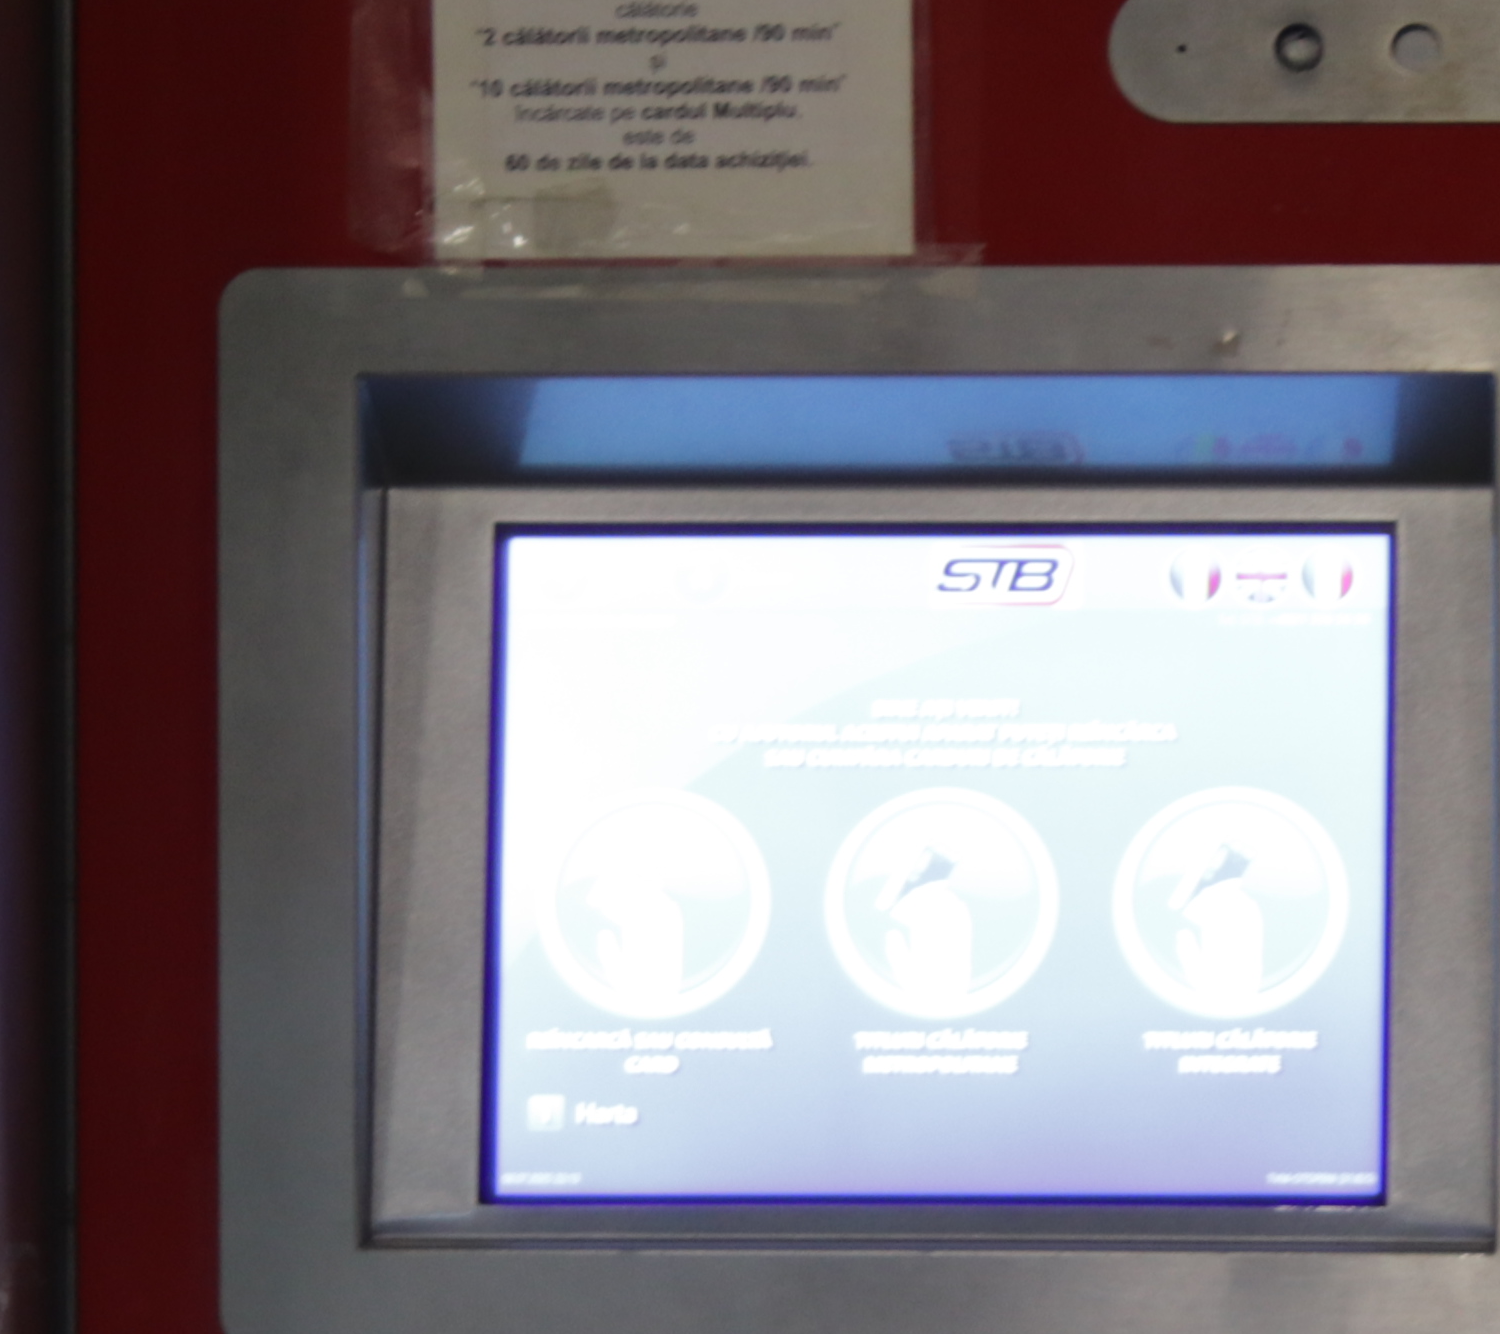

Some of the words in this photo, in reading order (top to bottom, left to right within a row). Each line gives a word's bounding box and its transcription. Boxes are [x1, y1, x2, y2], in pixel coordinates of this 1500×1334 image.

[596, 24, 746, 48] metropolitane
[603, 76, 753, 101] metropolitane
[610, 106, 634, 126] pe
[641, 102, 708, 121] cardul
[537, 153, 562, 172] de
[567, 152, 602, 173] zile
[608, 152, 633, 171] de
[664, 151, 709, 170] data
[937, 559, 1059, 593] STB
